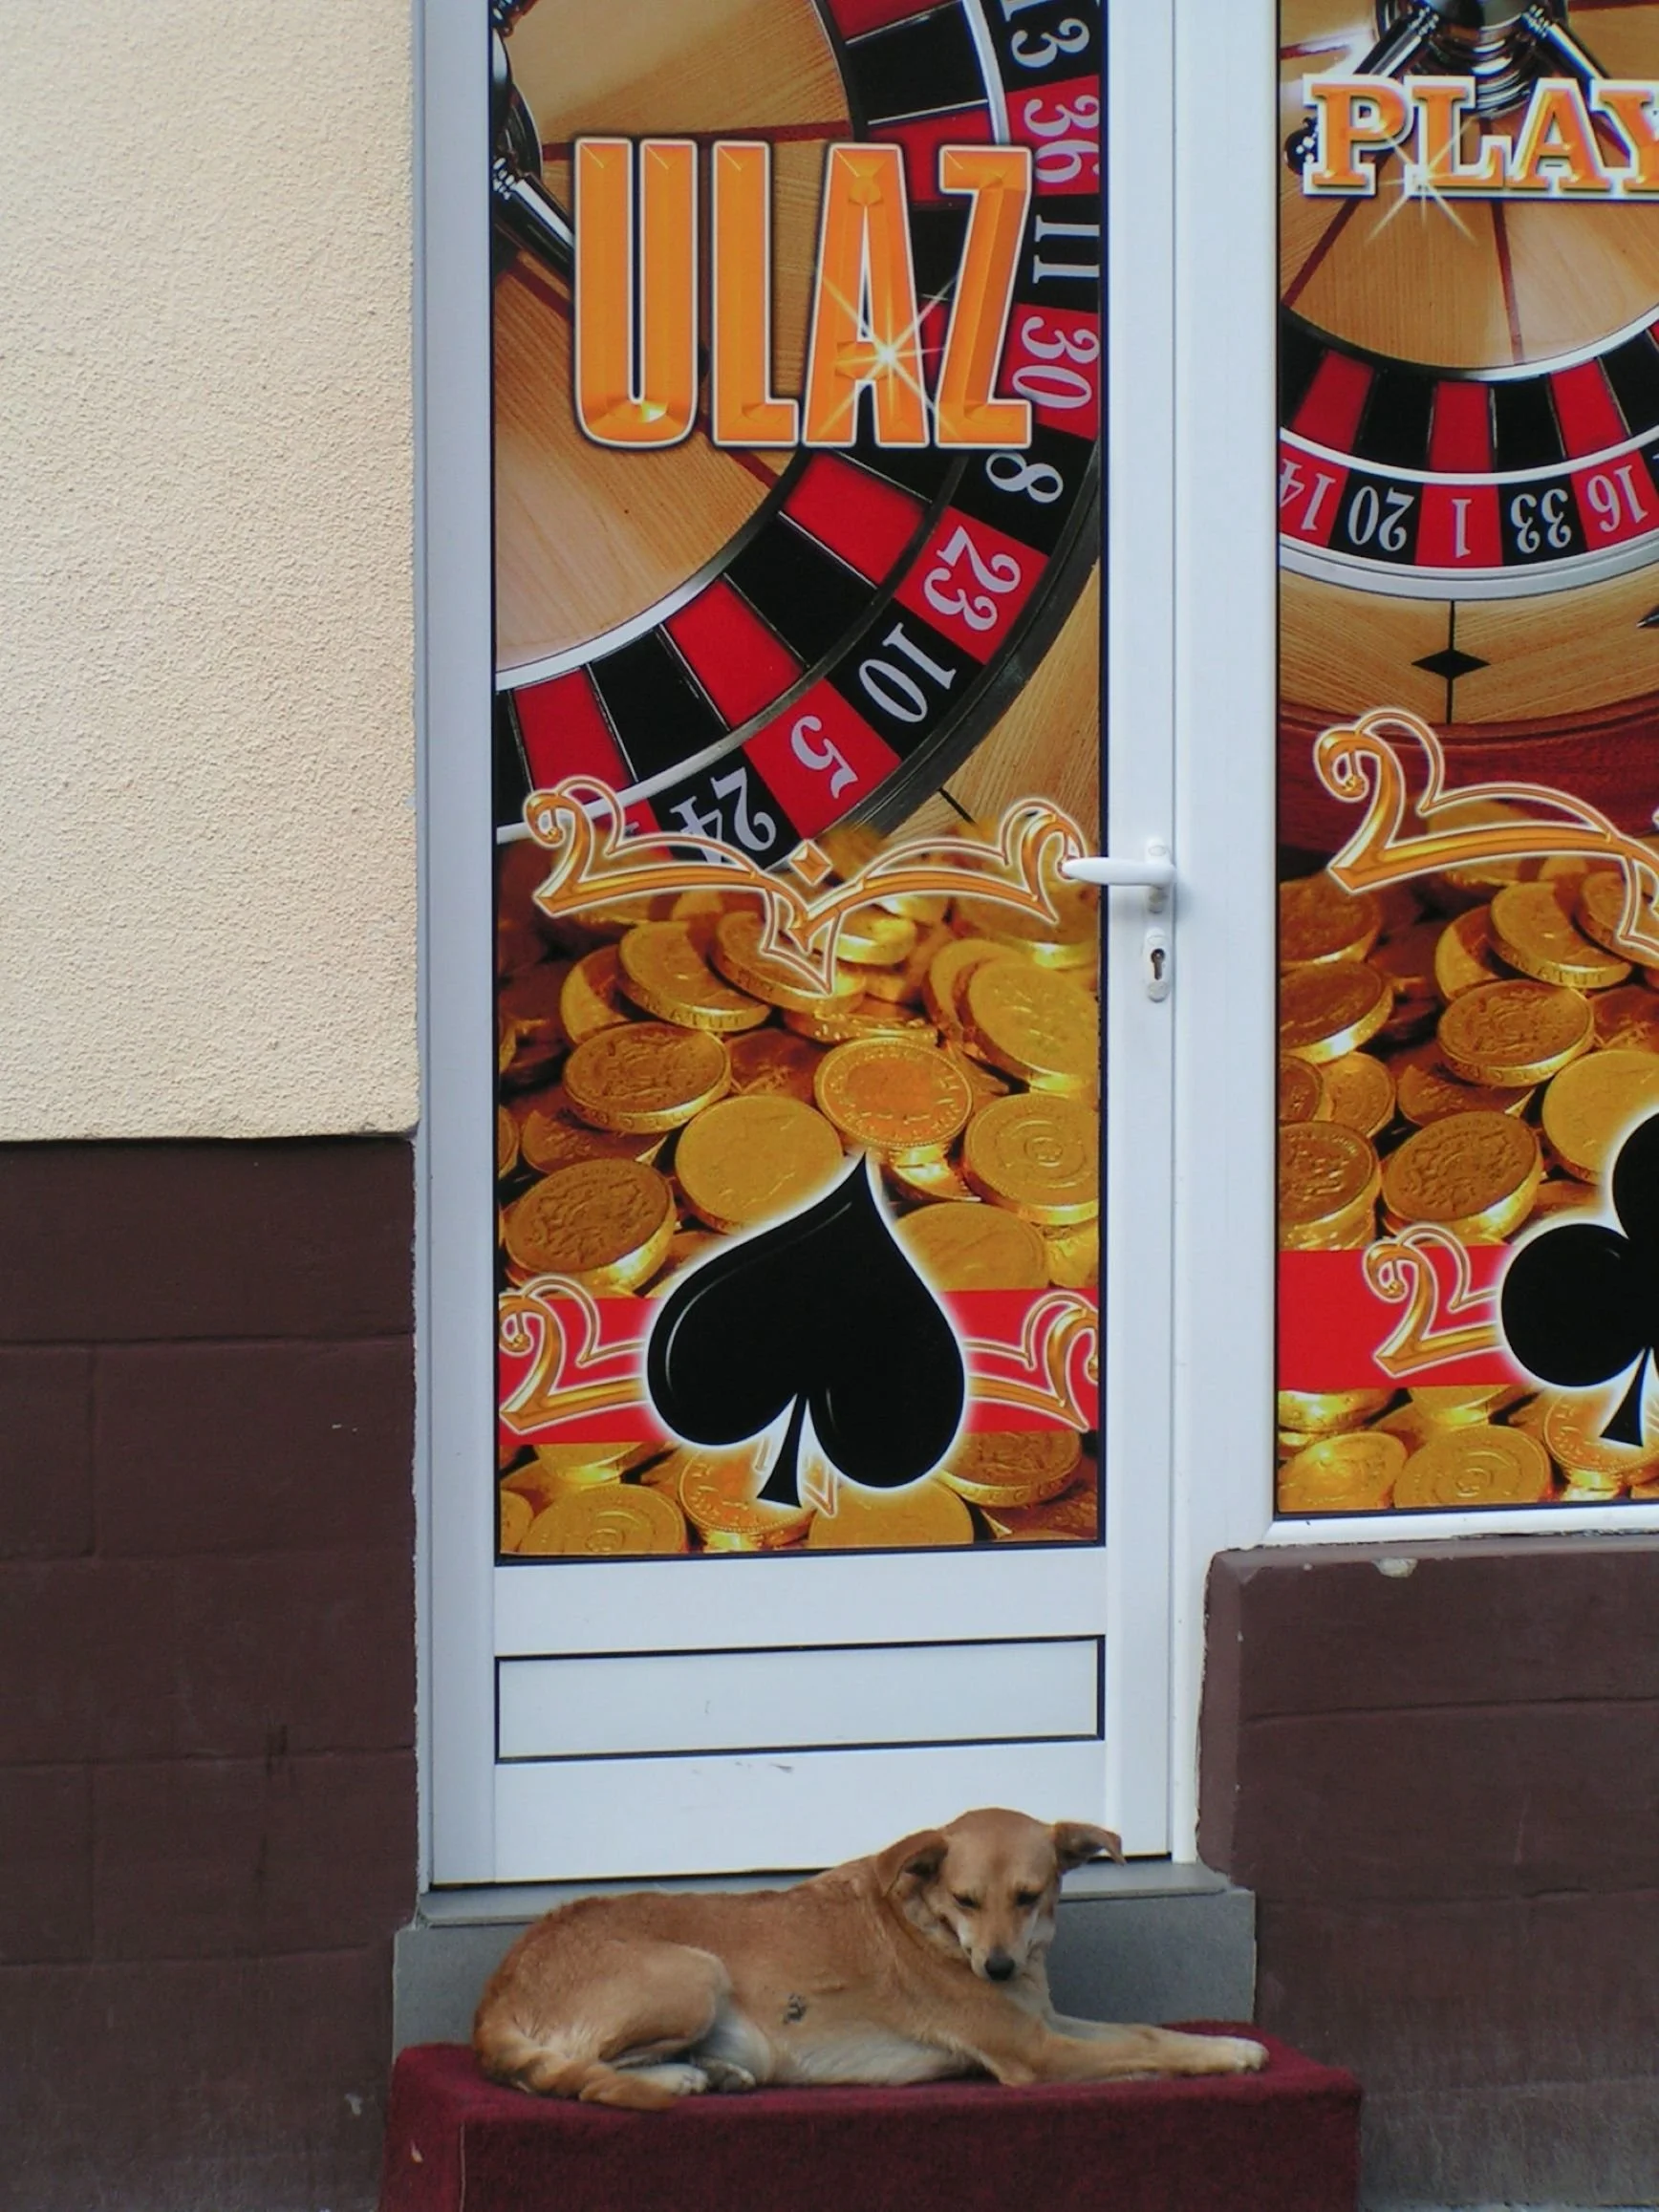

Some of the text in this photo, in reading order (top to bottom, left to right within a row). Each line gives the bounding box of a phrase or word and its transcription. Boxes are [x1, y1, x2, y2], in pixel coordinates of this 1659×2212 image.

[1023, 95, 1099, 183] 36
[575, 137, 1032, 449] ULAZ
[1012, 316, 1099, 409] 30
[986, 452, 1064, 504] 8
[1347, 485, 1414, 551] 20
[1587, 464, 1648, 532] 16
[1451, 498, 1473, 558] 1
[1510, 488, 1572, 554] 33
[923, 526, 1022, 631] 23
[858, 622, 957, 723] 10
[790, 716, 859, 799] 5
